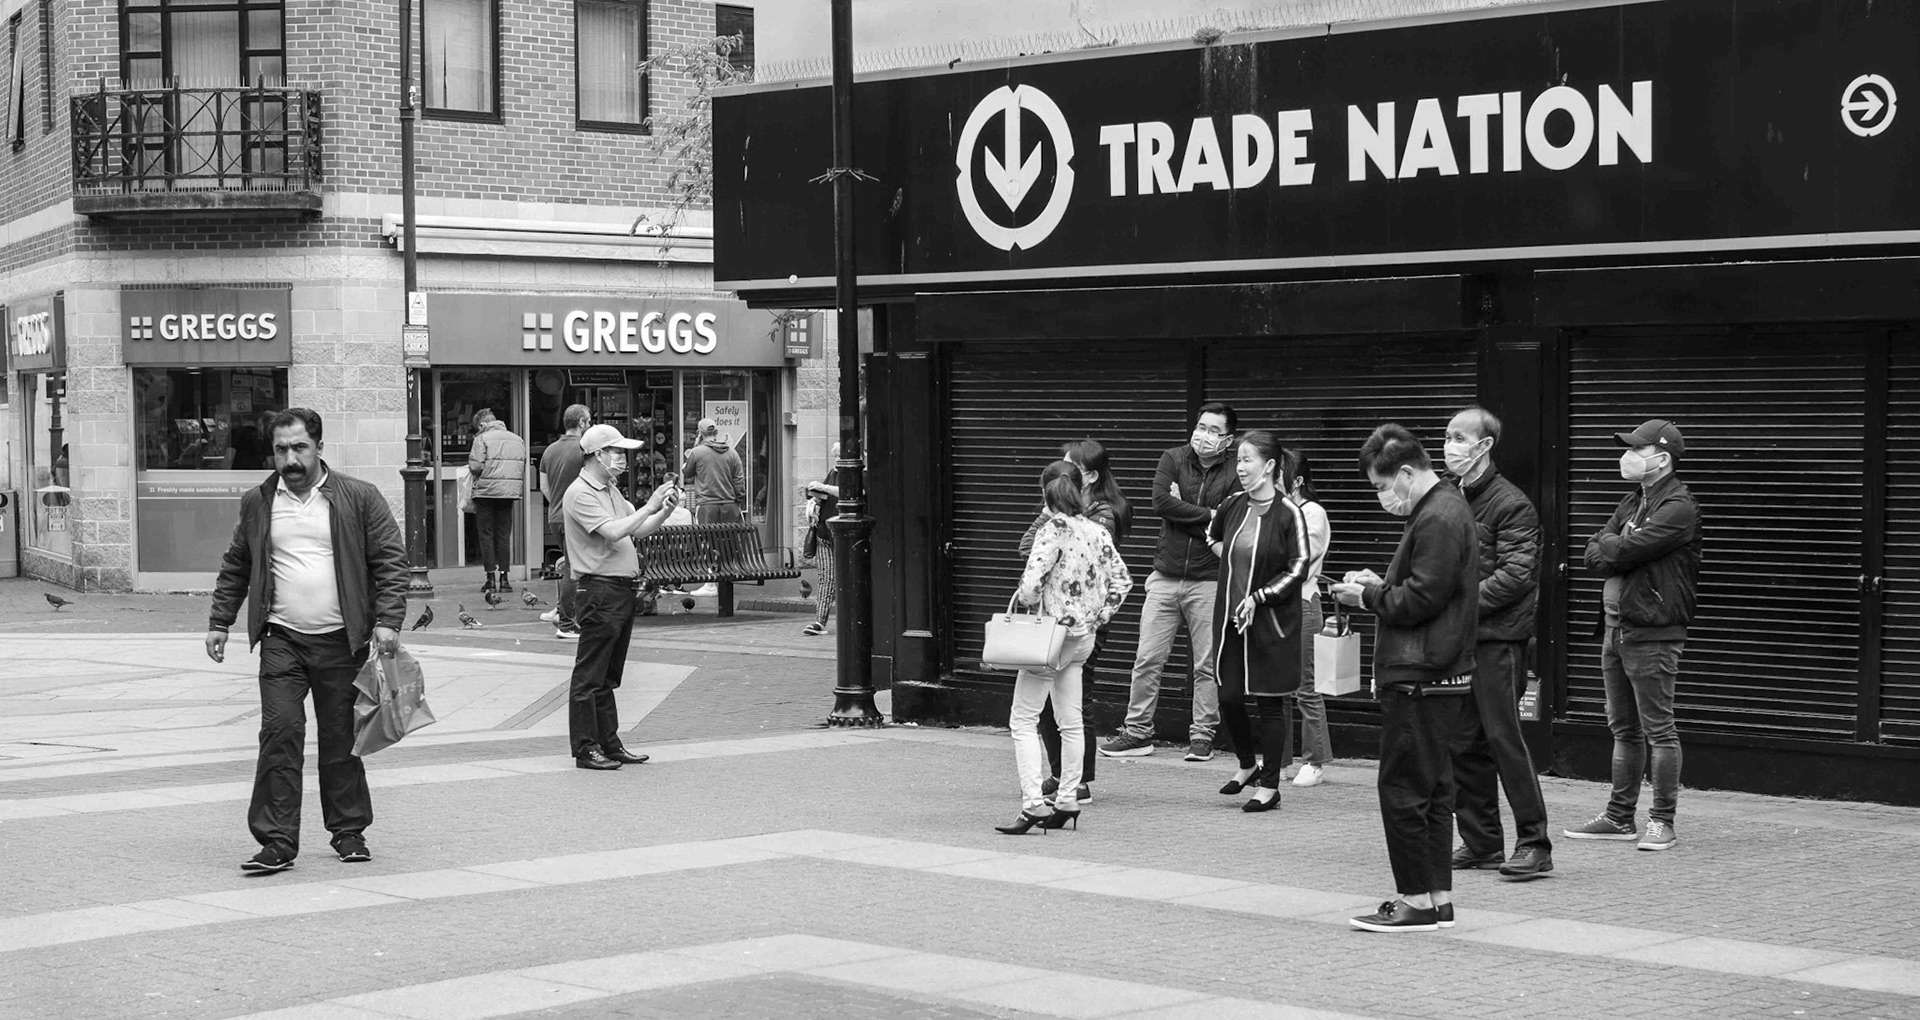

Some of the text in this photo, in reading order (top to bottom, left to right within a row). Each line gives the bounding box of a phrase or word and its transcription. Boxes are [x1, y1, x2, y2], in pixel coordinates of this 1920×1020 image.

[1099, 80, 1653, 197] TRADE NATION
[159, 312, 277, 340] GREGGS
[563, 309, 717, 354] GREGGS
[714, 405, 740, 416] Safely
[714, 416, 740, 426] does it
